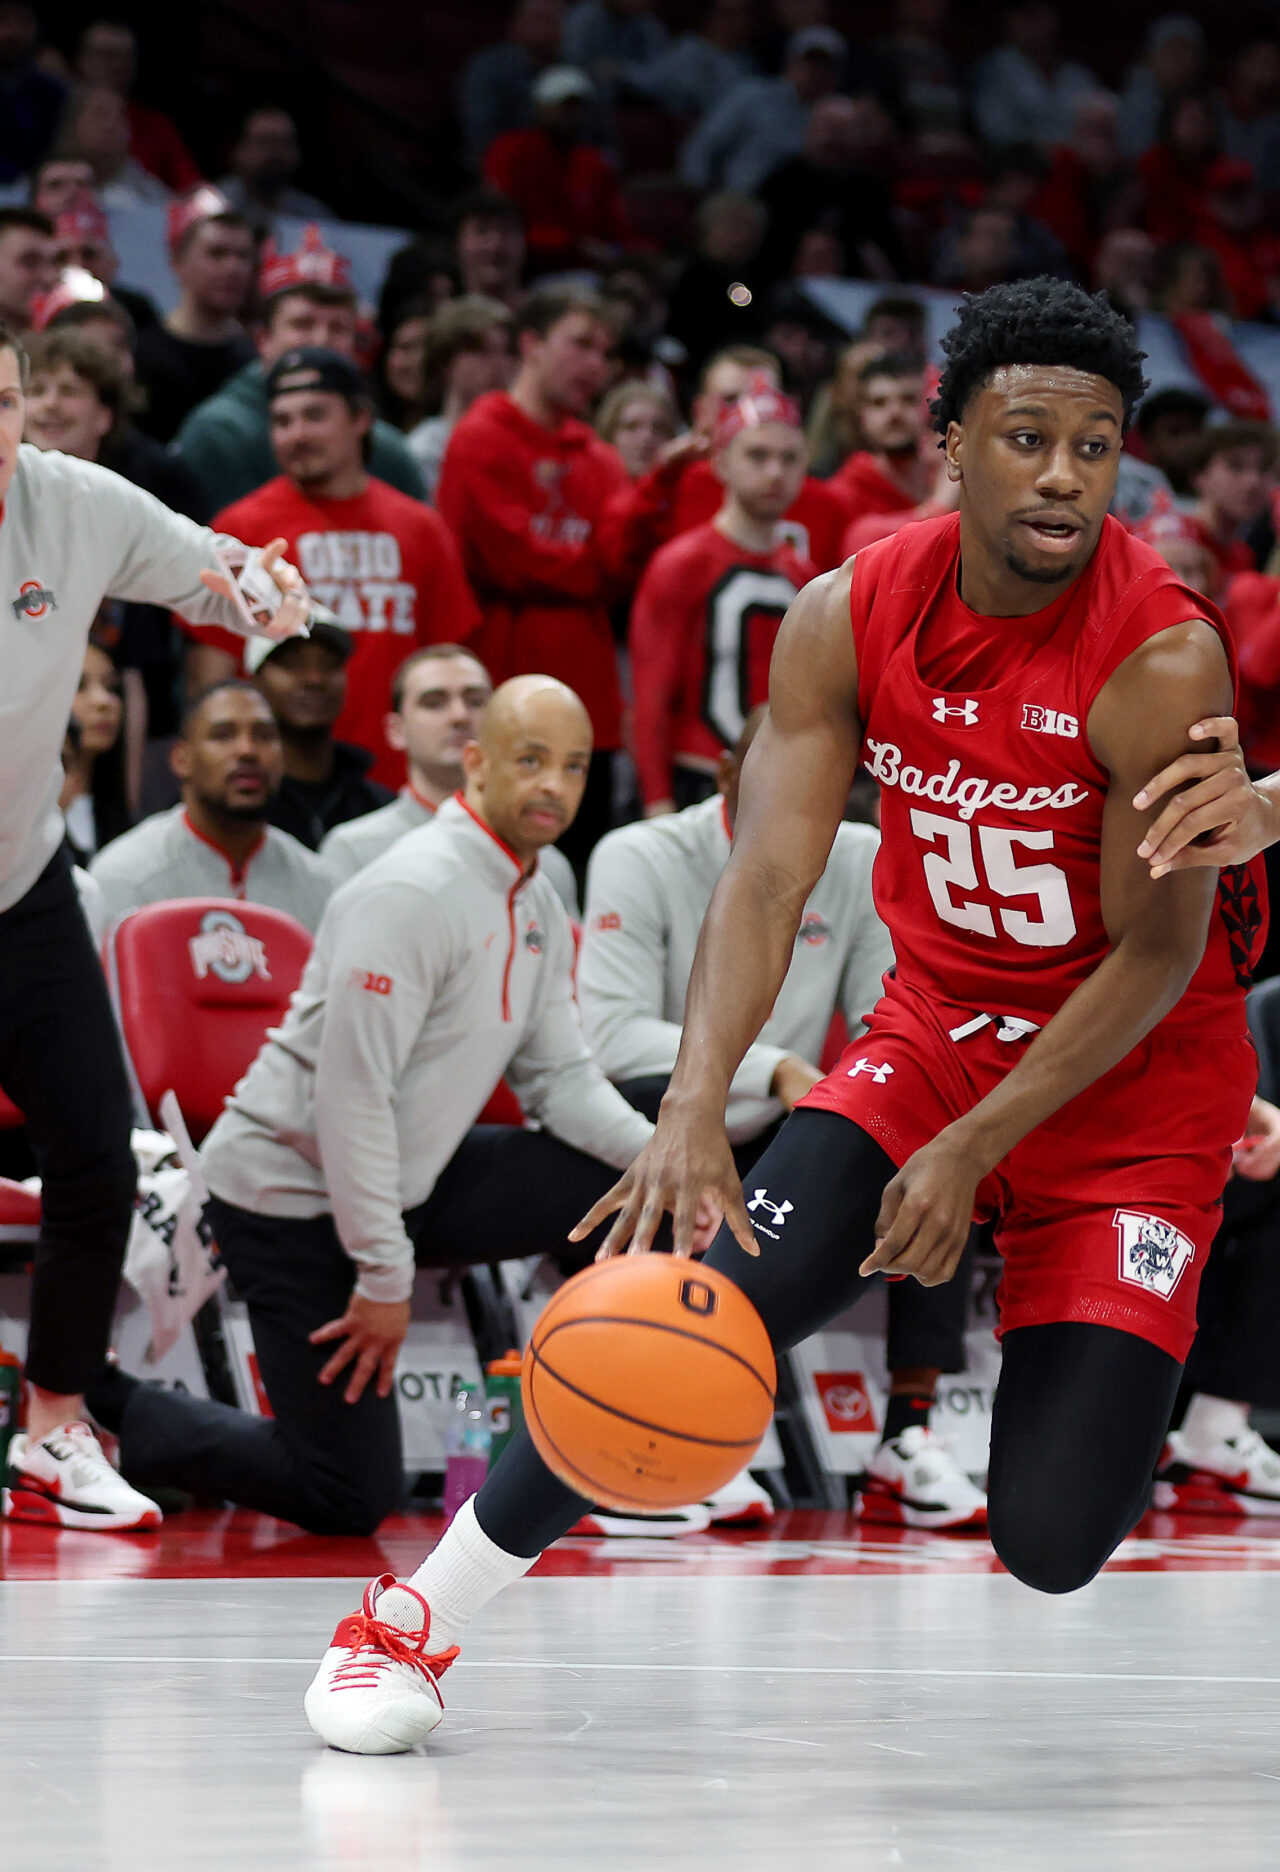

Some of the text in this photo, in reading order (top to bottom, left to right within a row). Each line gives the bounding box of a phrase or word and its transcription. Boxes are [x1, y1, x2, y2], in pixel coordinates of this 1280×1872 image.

[297, 531, 401, 579] OHIO
[306, 581, 417, 635] TATE
[863, 737, 1089, 819] Badgers
[909, 807, 1078, 948] 25
[400, 1371, 464, 1400] OTA
[485, 1397, 511, 1434] G
